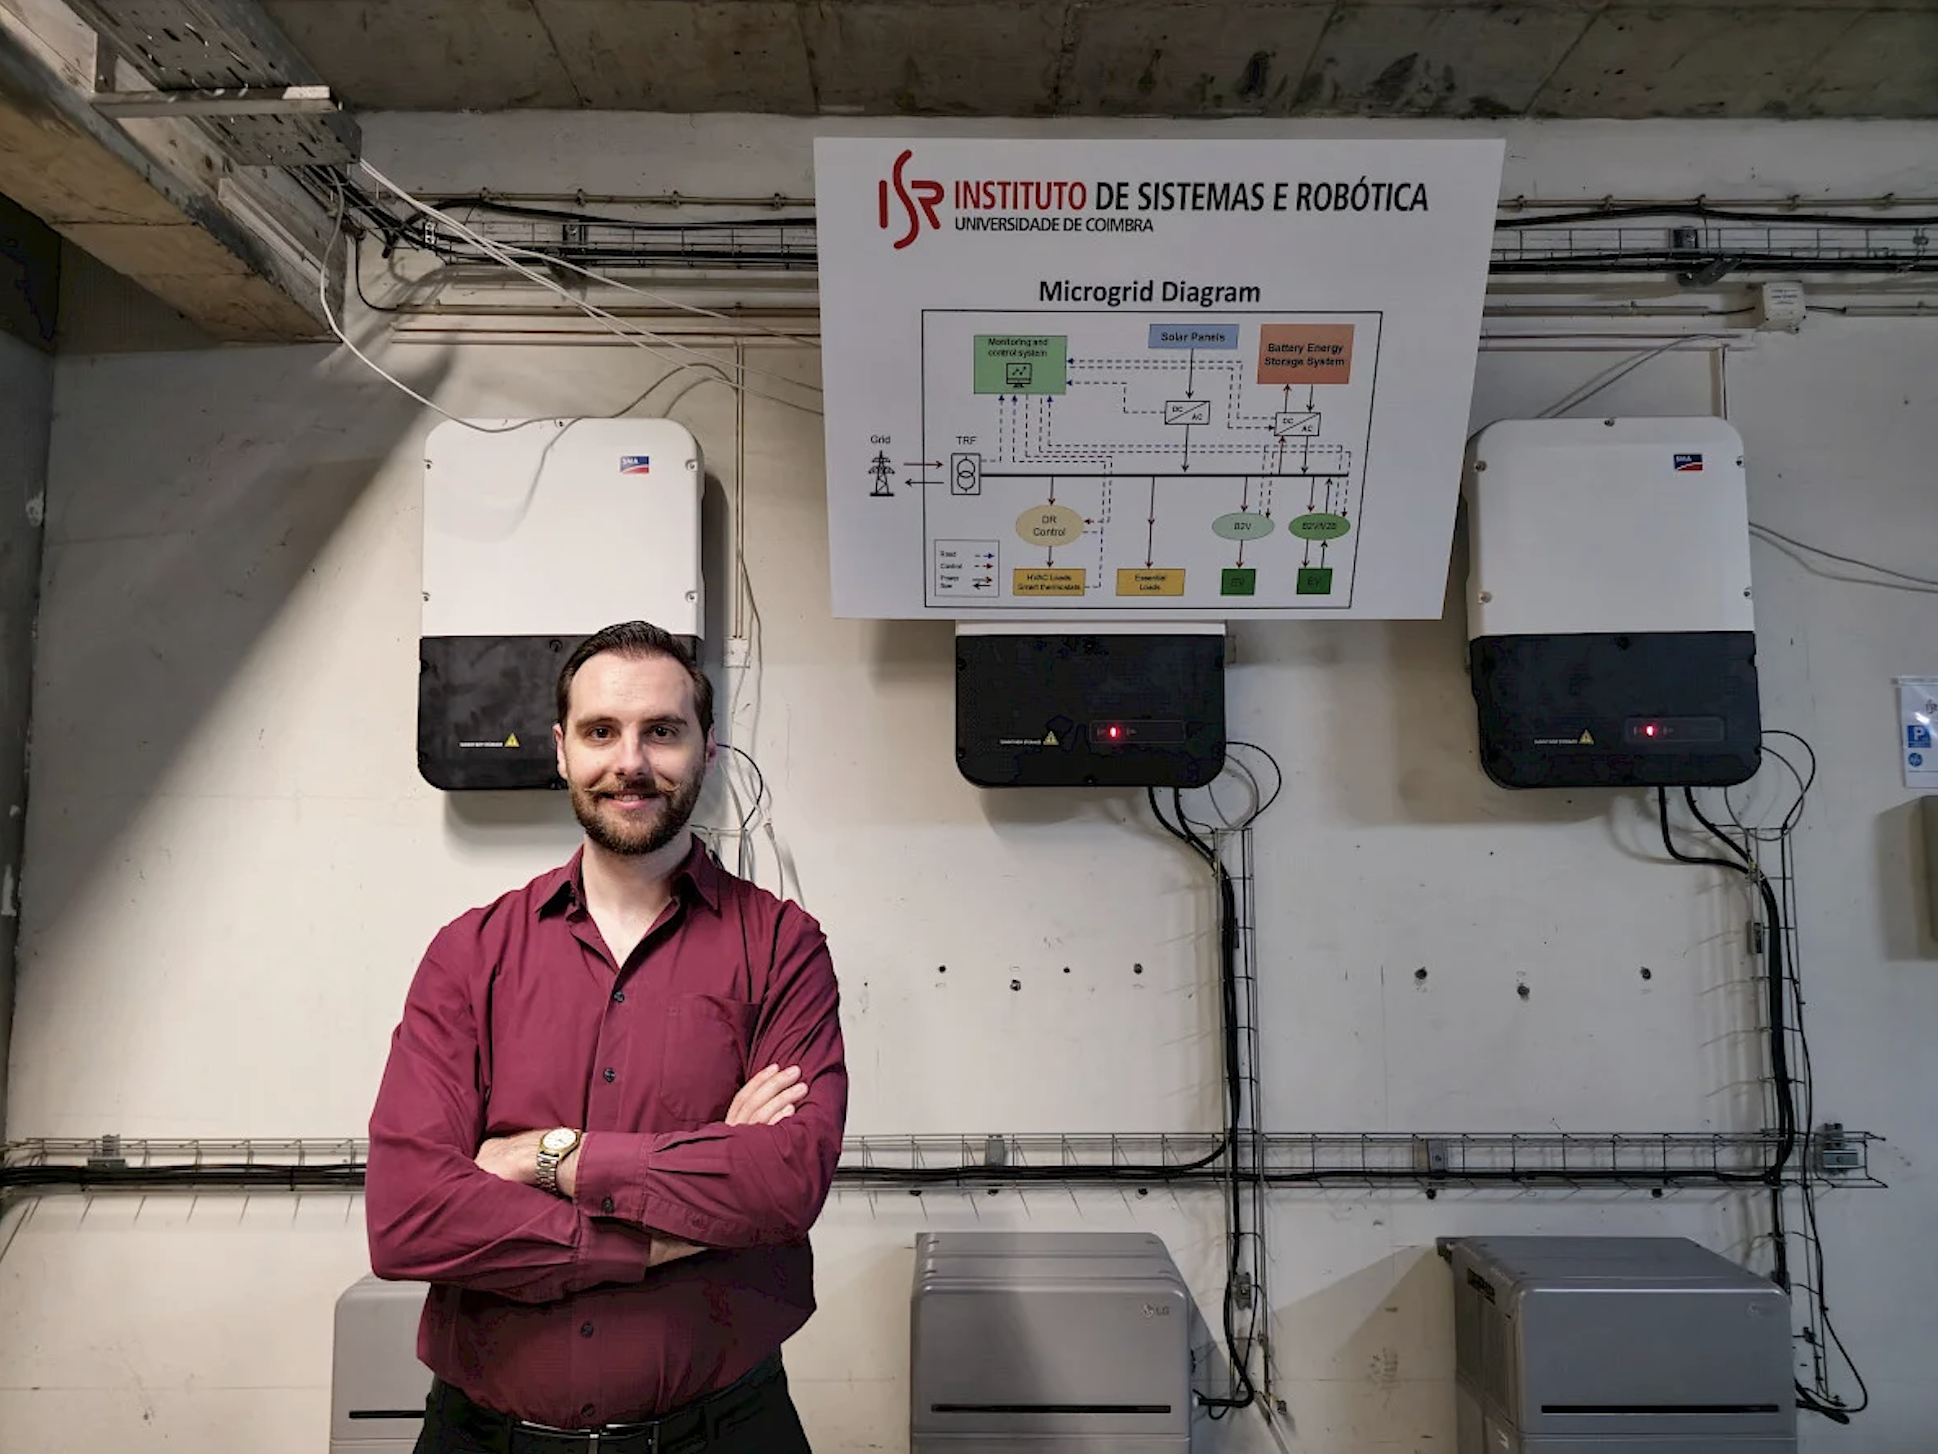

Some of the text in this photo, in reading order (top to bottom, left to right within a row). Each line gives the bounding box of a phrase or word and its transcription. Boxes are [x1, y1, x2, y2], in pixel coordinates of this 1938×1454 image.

[954, 175, 1428, 212] INSTITUTO DE SISTEMAS E ROBÓTICA
[879, 149, 945, 250] ISR
[954, 217, 1153, 233] UNIVERSIDADE DE COIMBRA
[1040, 280, 1261, 310] Microgrid Diagram
[1161, 332, 1225, 342] Solar Panels
[988, 338, 1048, 348] Monitoring and
[988, 348, 1047, 358] control system
[1268, 344, 1343, 354] Battery Energy
[1264, 357, 1345, 367] Storage System
[870, 435, 891, 444] Grid
[956, 436, 977, 445] TRF
[1042, 515, 1057, 524] DR
[1033, 527, 1066, 536] Control
[1914, 726, 1924, 741] P
